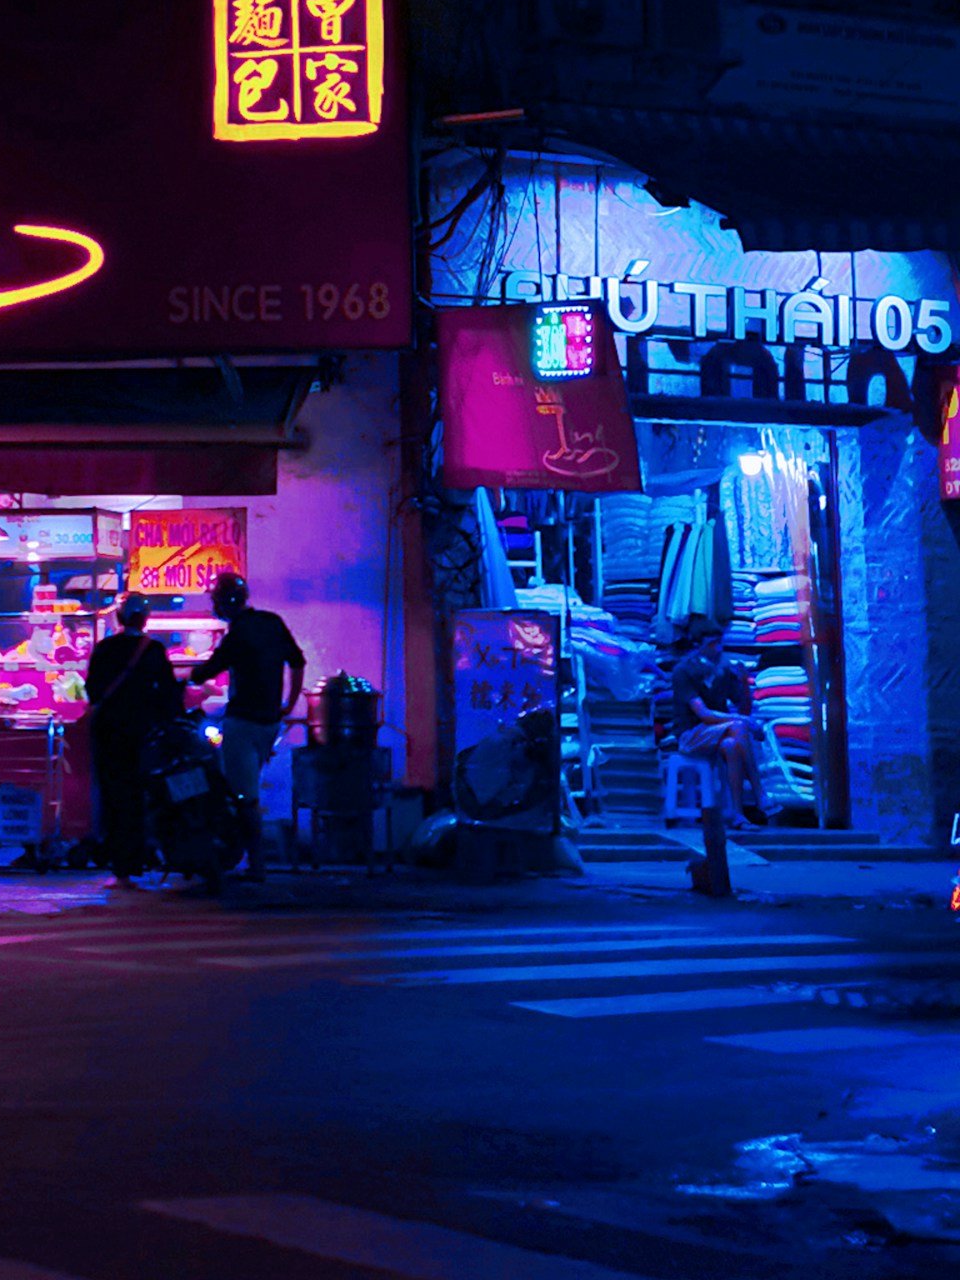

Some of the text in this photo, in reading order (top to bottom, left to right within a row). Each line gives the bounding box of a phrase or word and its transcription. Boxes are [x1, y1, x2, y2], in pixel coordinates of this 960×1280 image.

[168, 281, 391, 323] SINCE 1968
[673, 276, 850, 347] THÁI
[875, 295, 951, 353] 05
